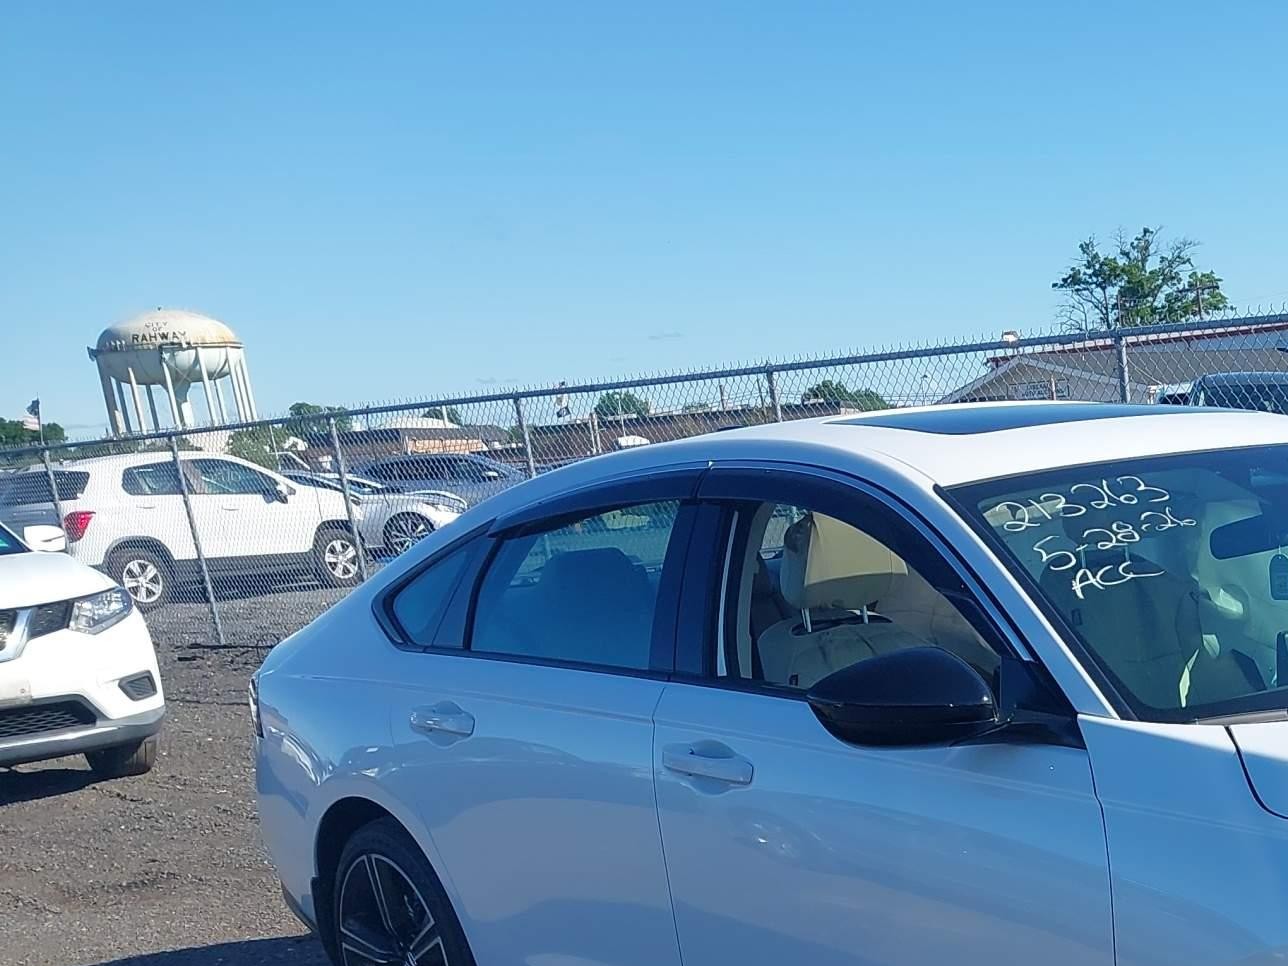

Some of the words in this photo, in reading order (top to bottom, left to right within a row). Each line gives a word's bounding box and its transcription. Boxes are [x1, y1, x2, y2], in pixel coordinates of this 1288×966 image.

[132, 330, 187, 344] RAHWAY
[145, 321, 168, 329] CITY
[995, 476, 1170, 532] 213263
[1071, 561, 1166, 600] ACC
